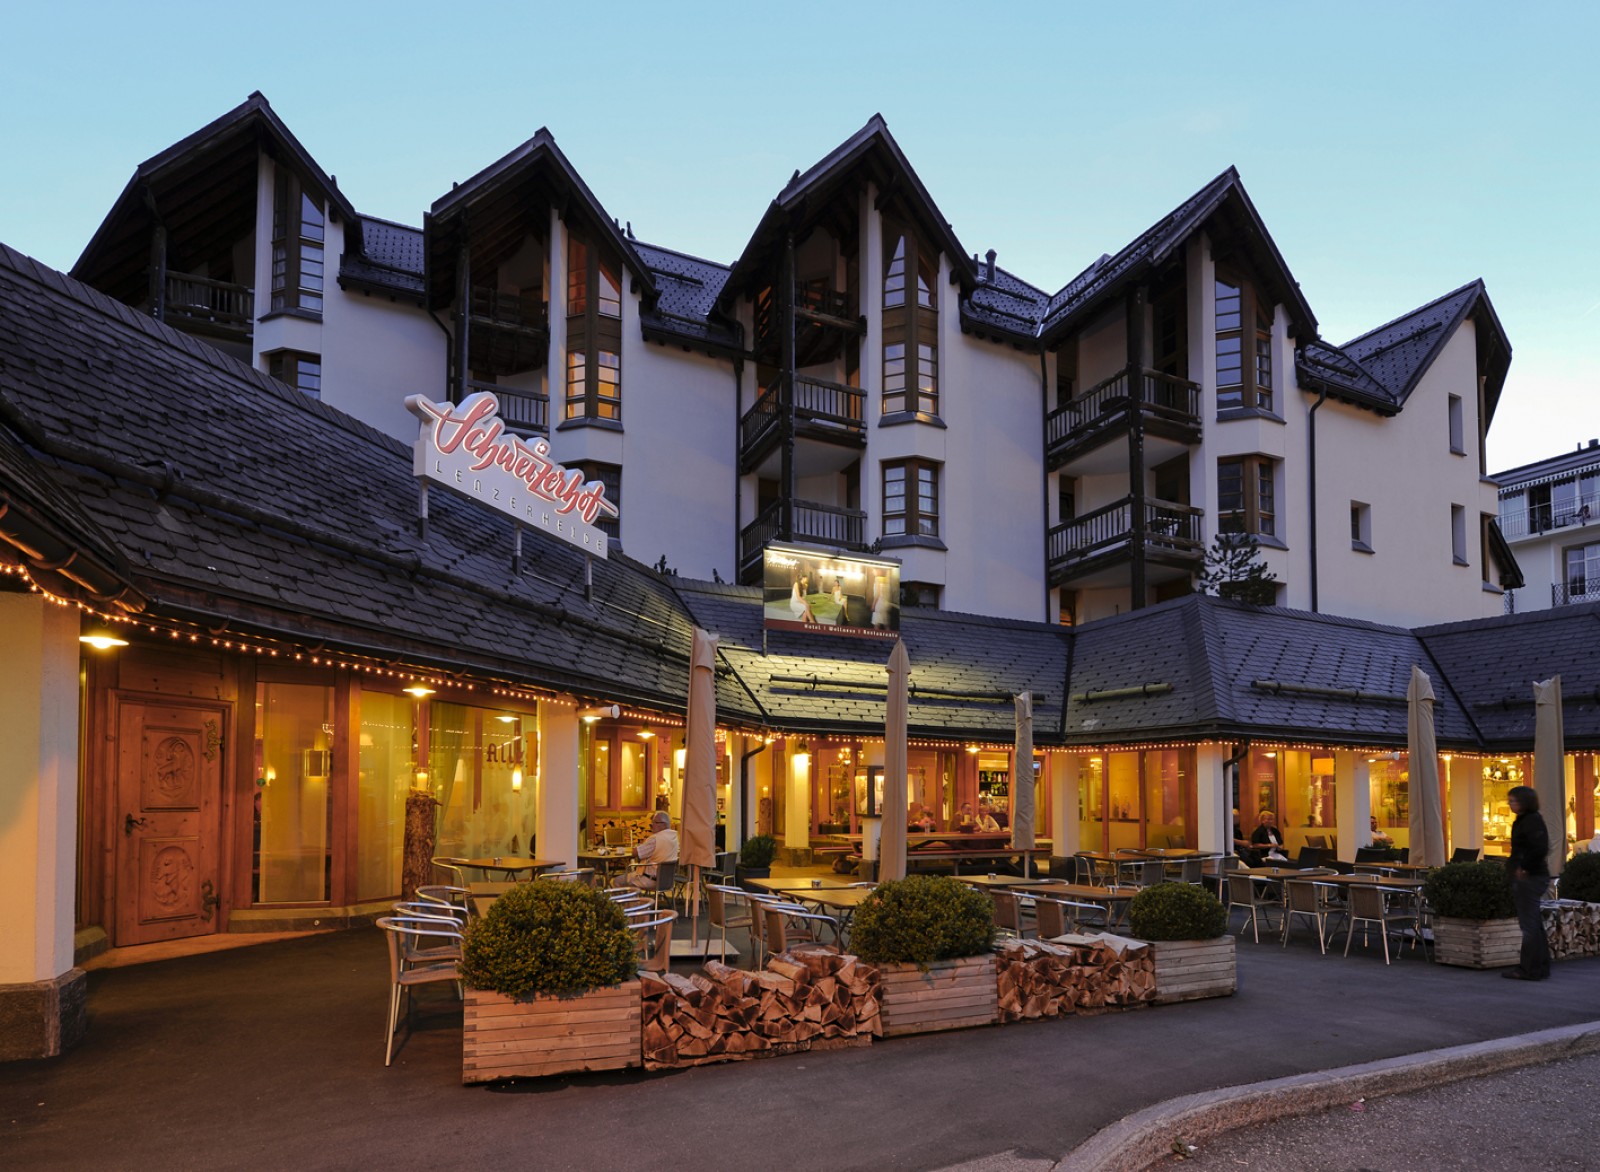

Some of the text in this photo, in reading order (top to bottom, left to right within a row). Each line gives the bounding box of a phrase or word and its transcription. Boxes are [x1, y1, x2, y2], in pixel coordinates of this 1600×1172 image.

[418, 396, 619, 524] Schweizerhof
[435, 459, 603, 552] LENZERHEIDE
[804, 623, 821, 631] Hotel
[828, 626, 856, 634] Wellness
